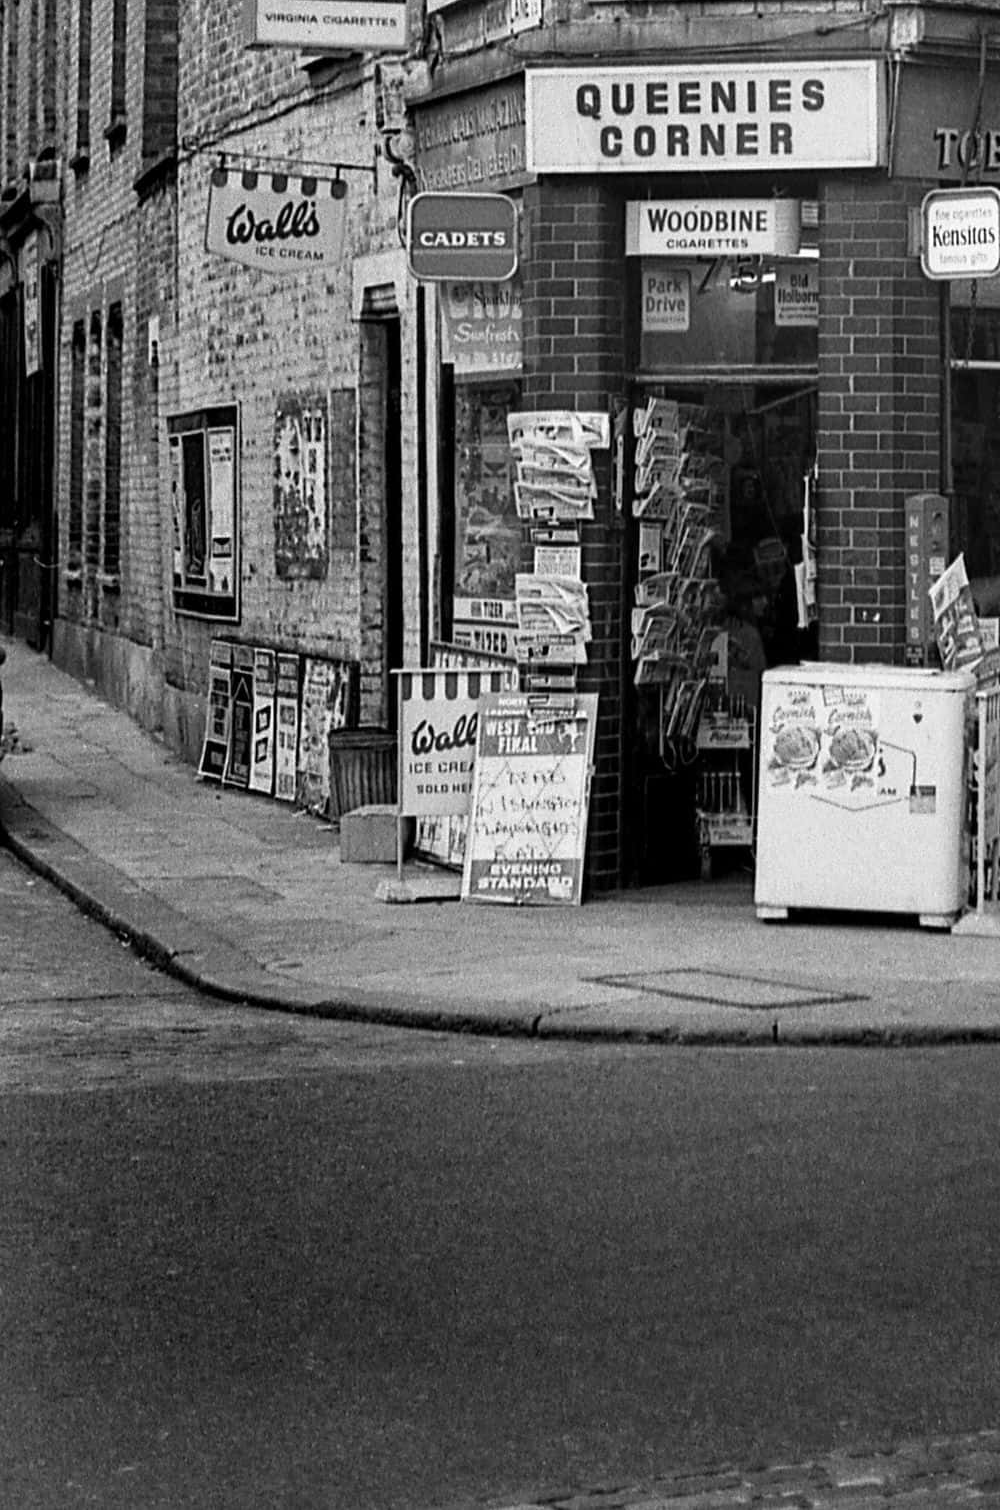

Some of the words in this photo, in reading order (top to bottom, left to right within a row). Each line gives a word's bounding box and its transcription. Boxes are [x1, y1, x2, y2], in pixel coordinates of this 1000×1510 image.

[265, 12, 318, 25] VIRGINIA
[323, 14, 397, 28] CIGARETTES
[576, 79, 825, 120] QUEENIES
[600, 122, 793, 158] CORNER
[226, 200, 320, 245] Wall's
[647, 208, 768, 233] WOODBINE
[420, 231, 506, 247] CADETS
[666, 238, 749, 249] CIGARETTES
[932, 225, 996, 248] Kensitas
[255, 246, 275, 258] ICE
[279, 248, 324, 261] CREAM
[647, 278, 683, 294] Park
[790, 273, 809, 288] Old
[645, 295, 686, 313] Drive
[411, 712, 479, 756] Wall
[485, 720, 519, 736] WEST
[498, 735, 538, 754] FINAL
[409, 761, 433, 774] ICE
[438, 761, 474, 774] CRE
[416, 783, 449, 794] SOLD
[452, 783, 473, 794] HE
[490, 864, 561, 876] EVENING
[478, 876, 574, 889] STANDARD
